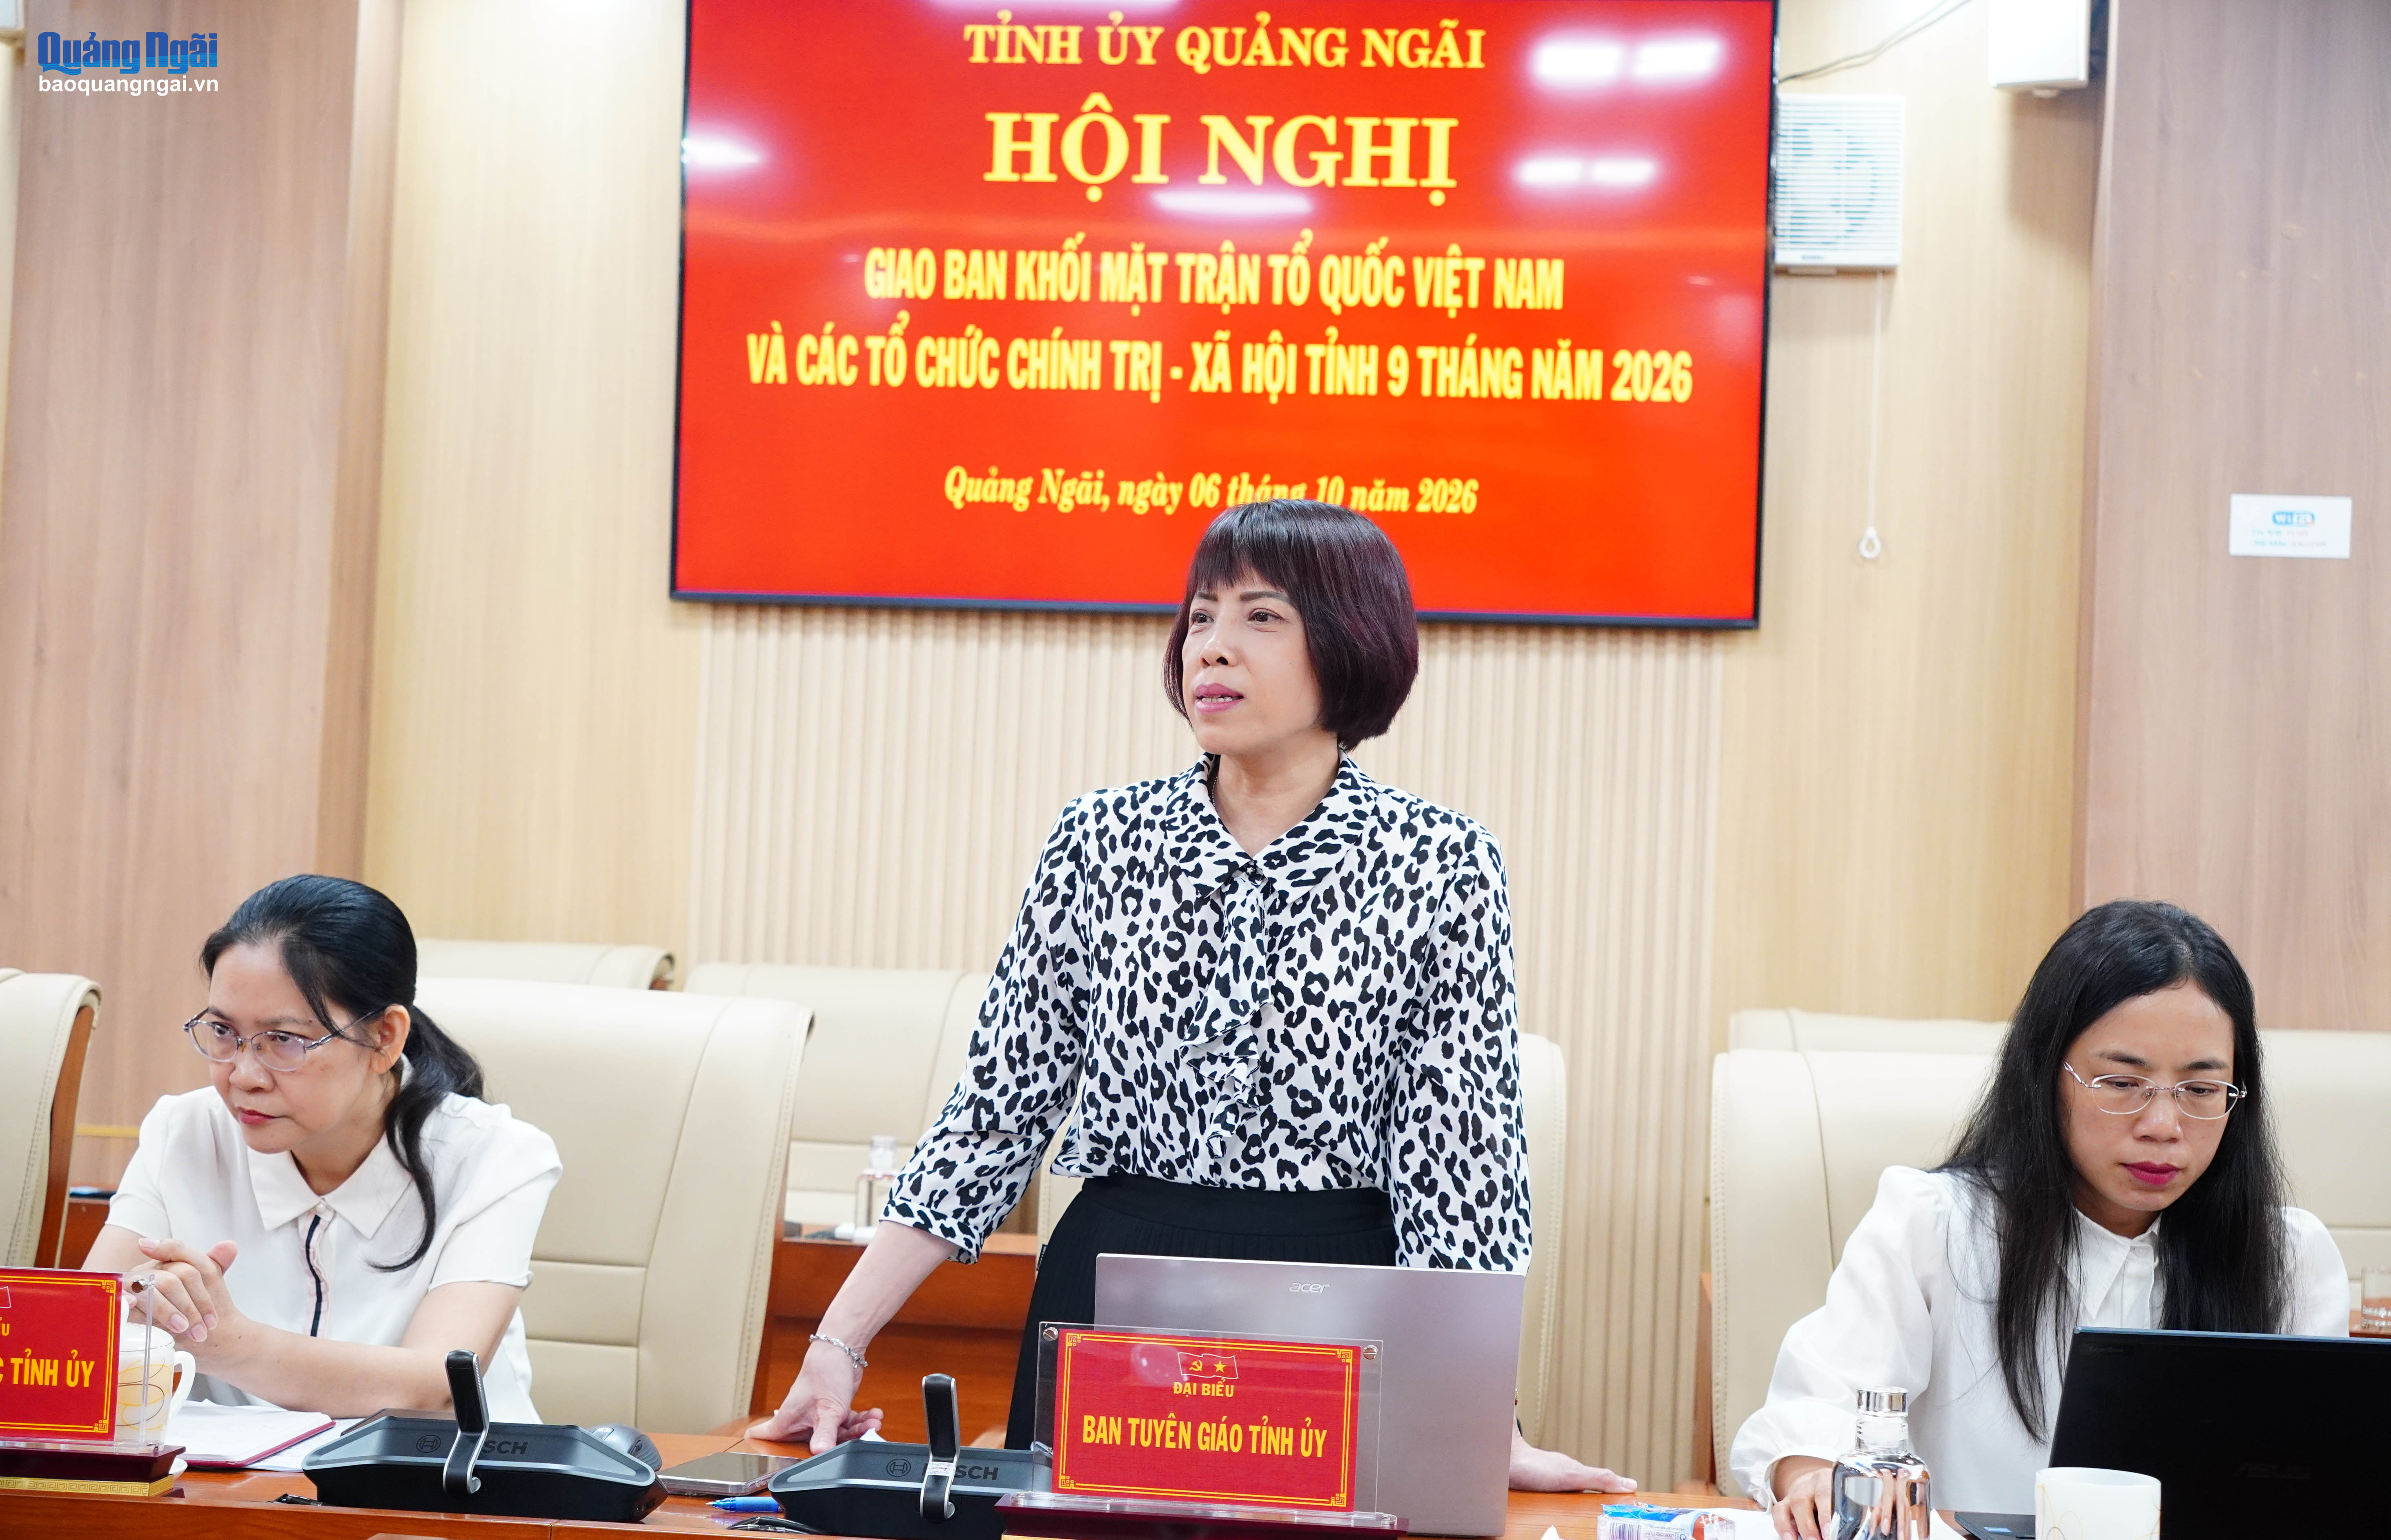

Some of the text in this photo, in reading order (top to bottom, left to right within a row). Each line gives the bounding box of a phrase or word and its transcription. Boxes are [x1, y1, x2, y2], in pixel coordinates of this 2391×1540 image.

[964, 10, 1486, 74] TỈNH ỦY QUẢNG NGÃI
[984, 92, 1459, 207] HỘI NGHỊ
[864, 228, 1565, 318] GIAO BAN KHỐI MẶT TRẬN TỔ QUỐC VIỆT NAM
[747, 309, 1693, 405] VÀ CÁC TỔ CHỨC CHÍNH TRỊ - XÃ HỘI TỈNH 9 THÁNG NĂM 2026
[945, 465, 1034, 512] Quảng
[1037, 468, 1110, 513] Ngãi,
[1117, 471, 1183, 515] ngày
[1189, 472, 1222, 508] 06
[1316, 475, 1345, 505] 10
[1349, 477, 1411, 513] năm
[1415, 477, 1479, 514] 2026
[1289, 1282, 1331, 1293] acer
[11, 1348, 58, 1386] TỈNH
[66, 1349, 95, 1388] ỦY
[1173, 1378, 1234, 1398] ĐẠI BIỂU
[482, 1440, 529, 1455] SCH
[1082, 1412, 1327, 1458] BAN TUYÊN GIÁO TỈNH ỦY
